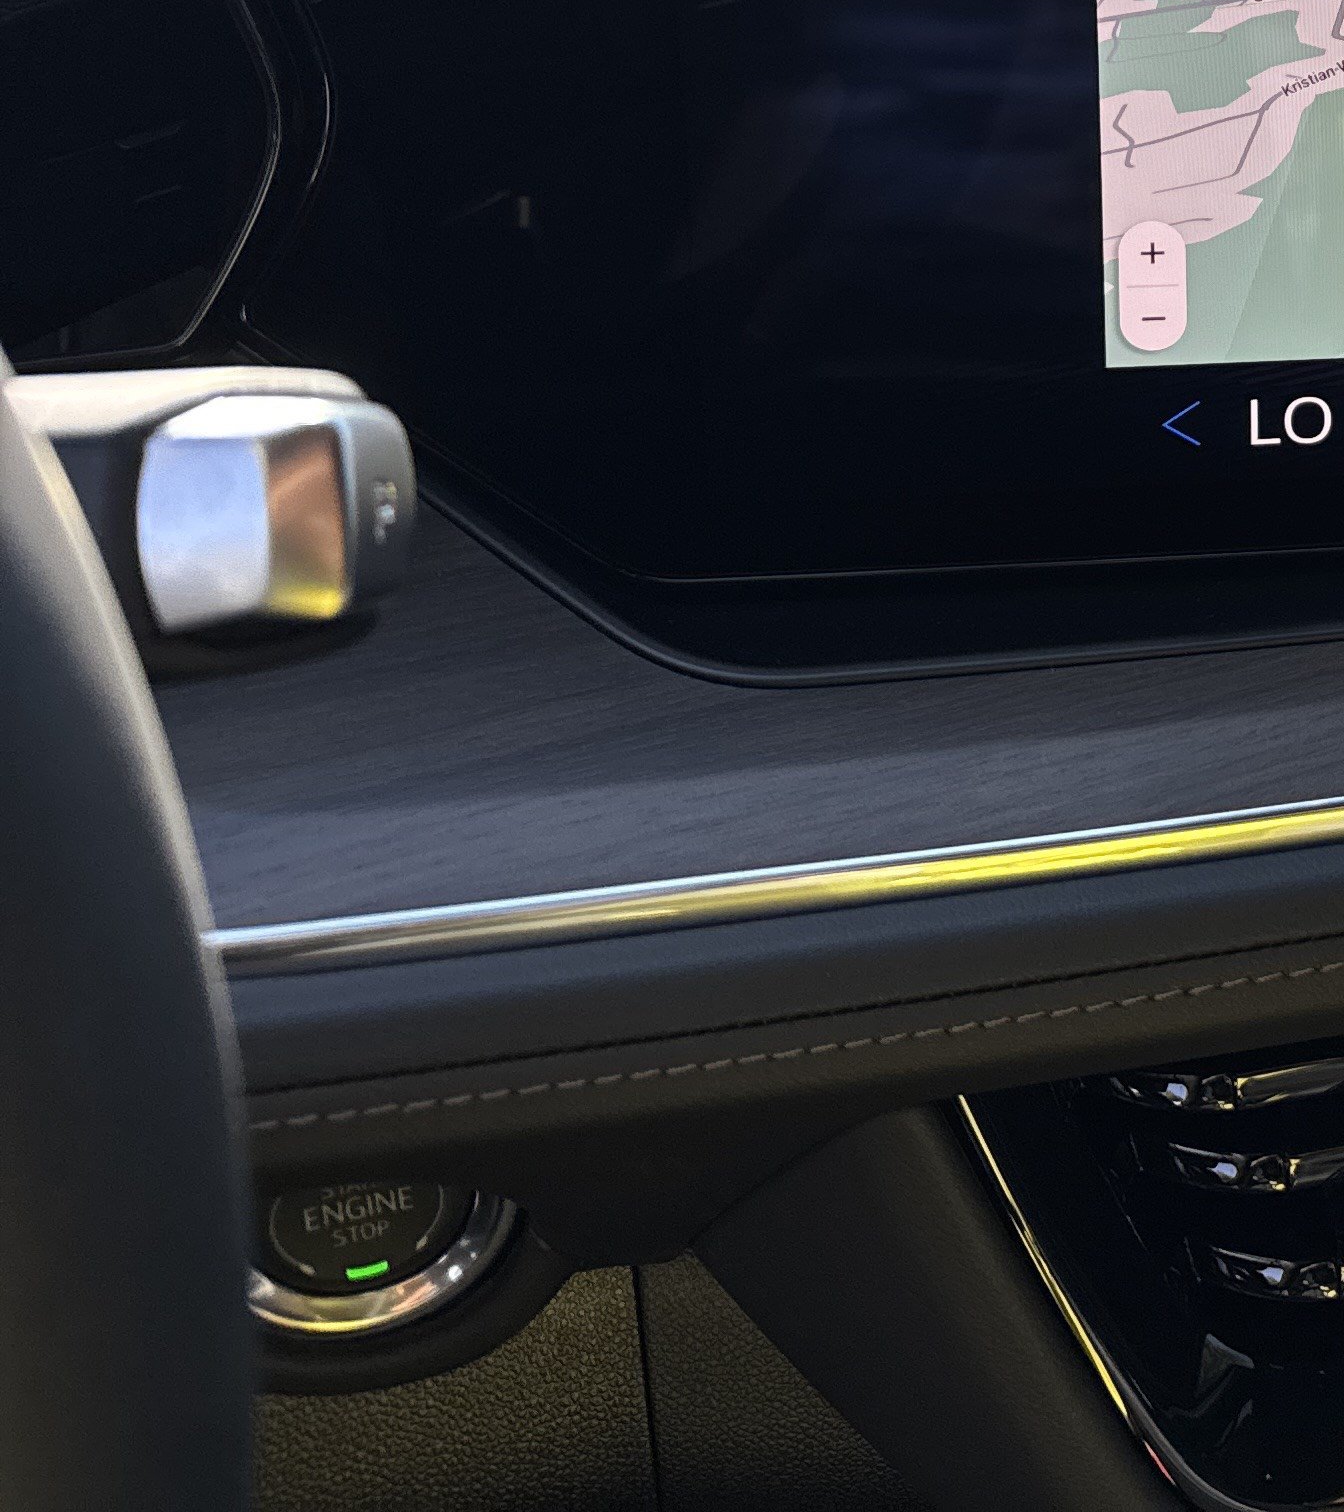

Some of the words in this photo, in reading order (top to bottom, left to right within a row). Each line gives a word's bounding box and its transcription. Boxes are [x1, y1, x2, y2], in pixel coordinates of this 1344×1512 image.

[1280, 67, 1337, 97] Kristian
[1250, 396, 1332, 446] LO
[303, 1186, 415, 1232] ENGINE
[332, 1219, 392, 1248] STOP
